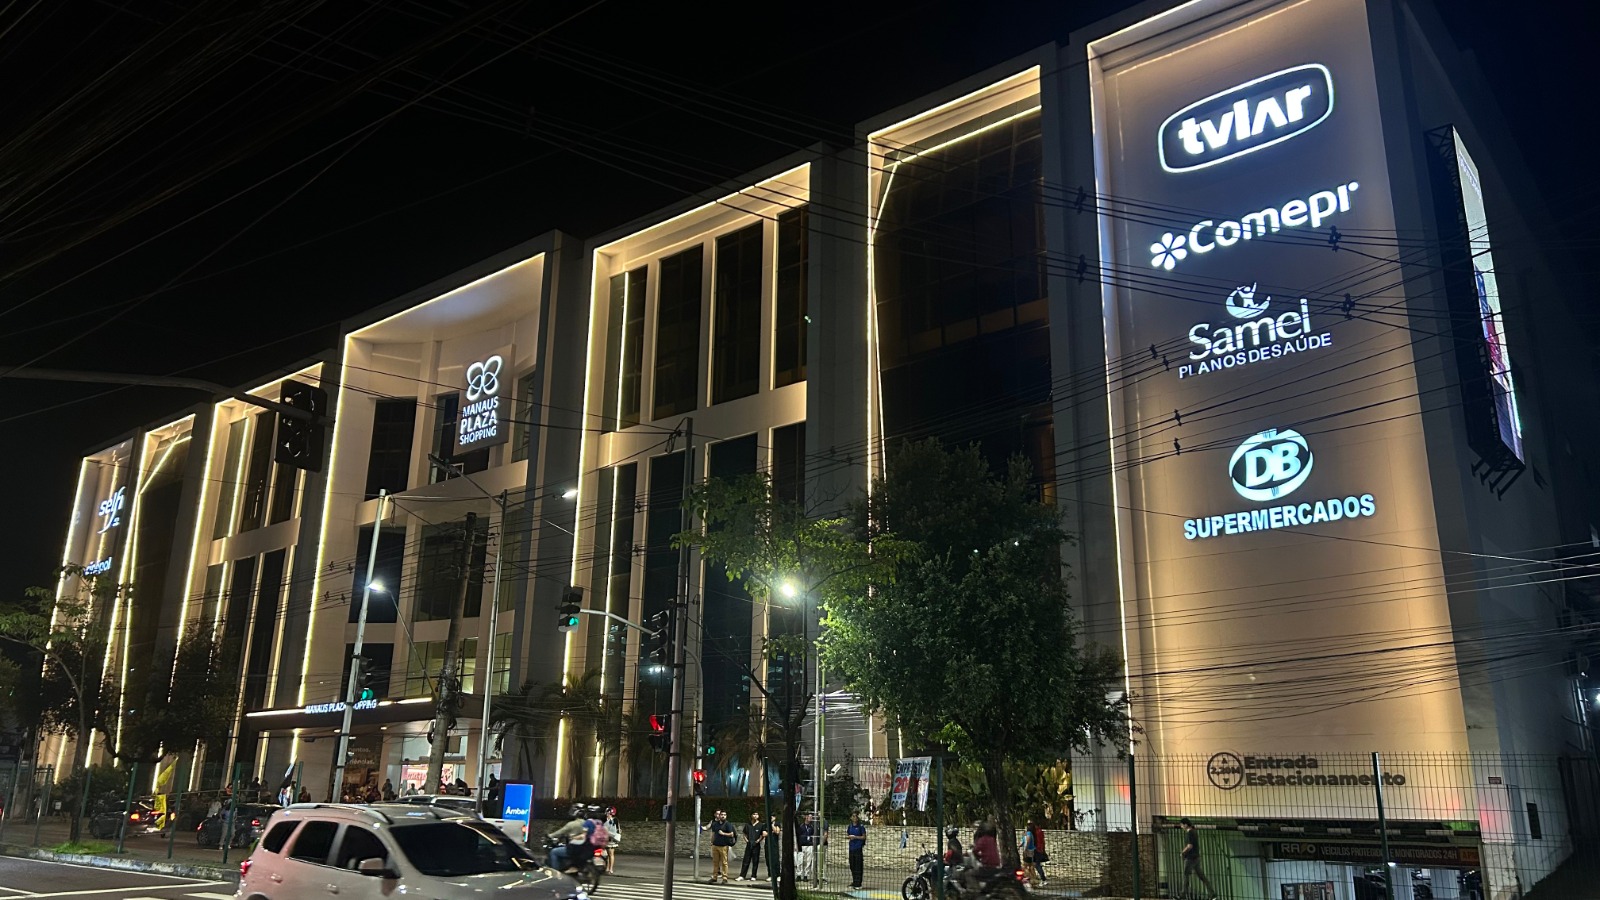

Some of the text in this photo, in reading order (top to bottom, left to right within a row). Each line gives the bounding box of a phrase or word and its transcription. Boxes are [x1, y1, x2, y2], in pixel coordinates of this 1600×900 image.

[1188, 298, 1312, 360] Samel
[462, 396, 499, 417] MANAUS
[460, 409, 497, 434] PLAZA
[459, 426, 497, 445] SHOPPING
[1245, 442, 1302, 487] DB
[1183, 493, 1376, 540] SUPERMERCADOS
[353, 699, 377, 710] OPPING
[1244, 755, 1319, 769] Entrada
